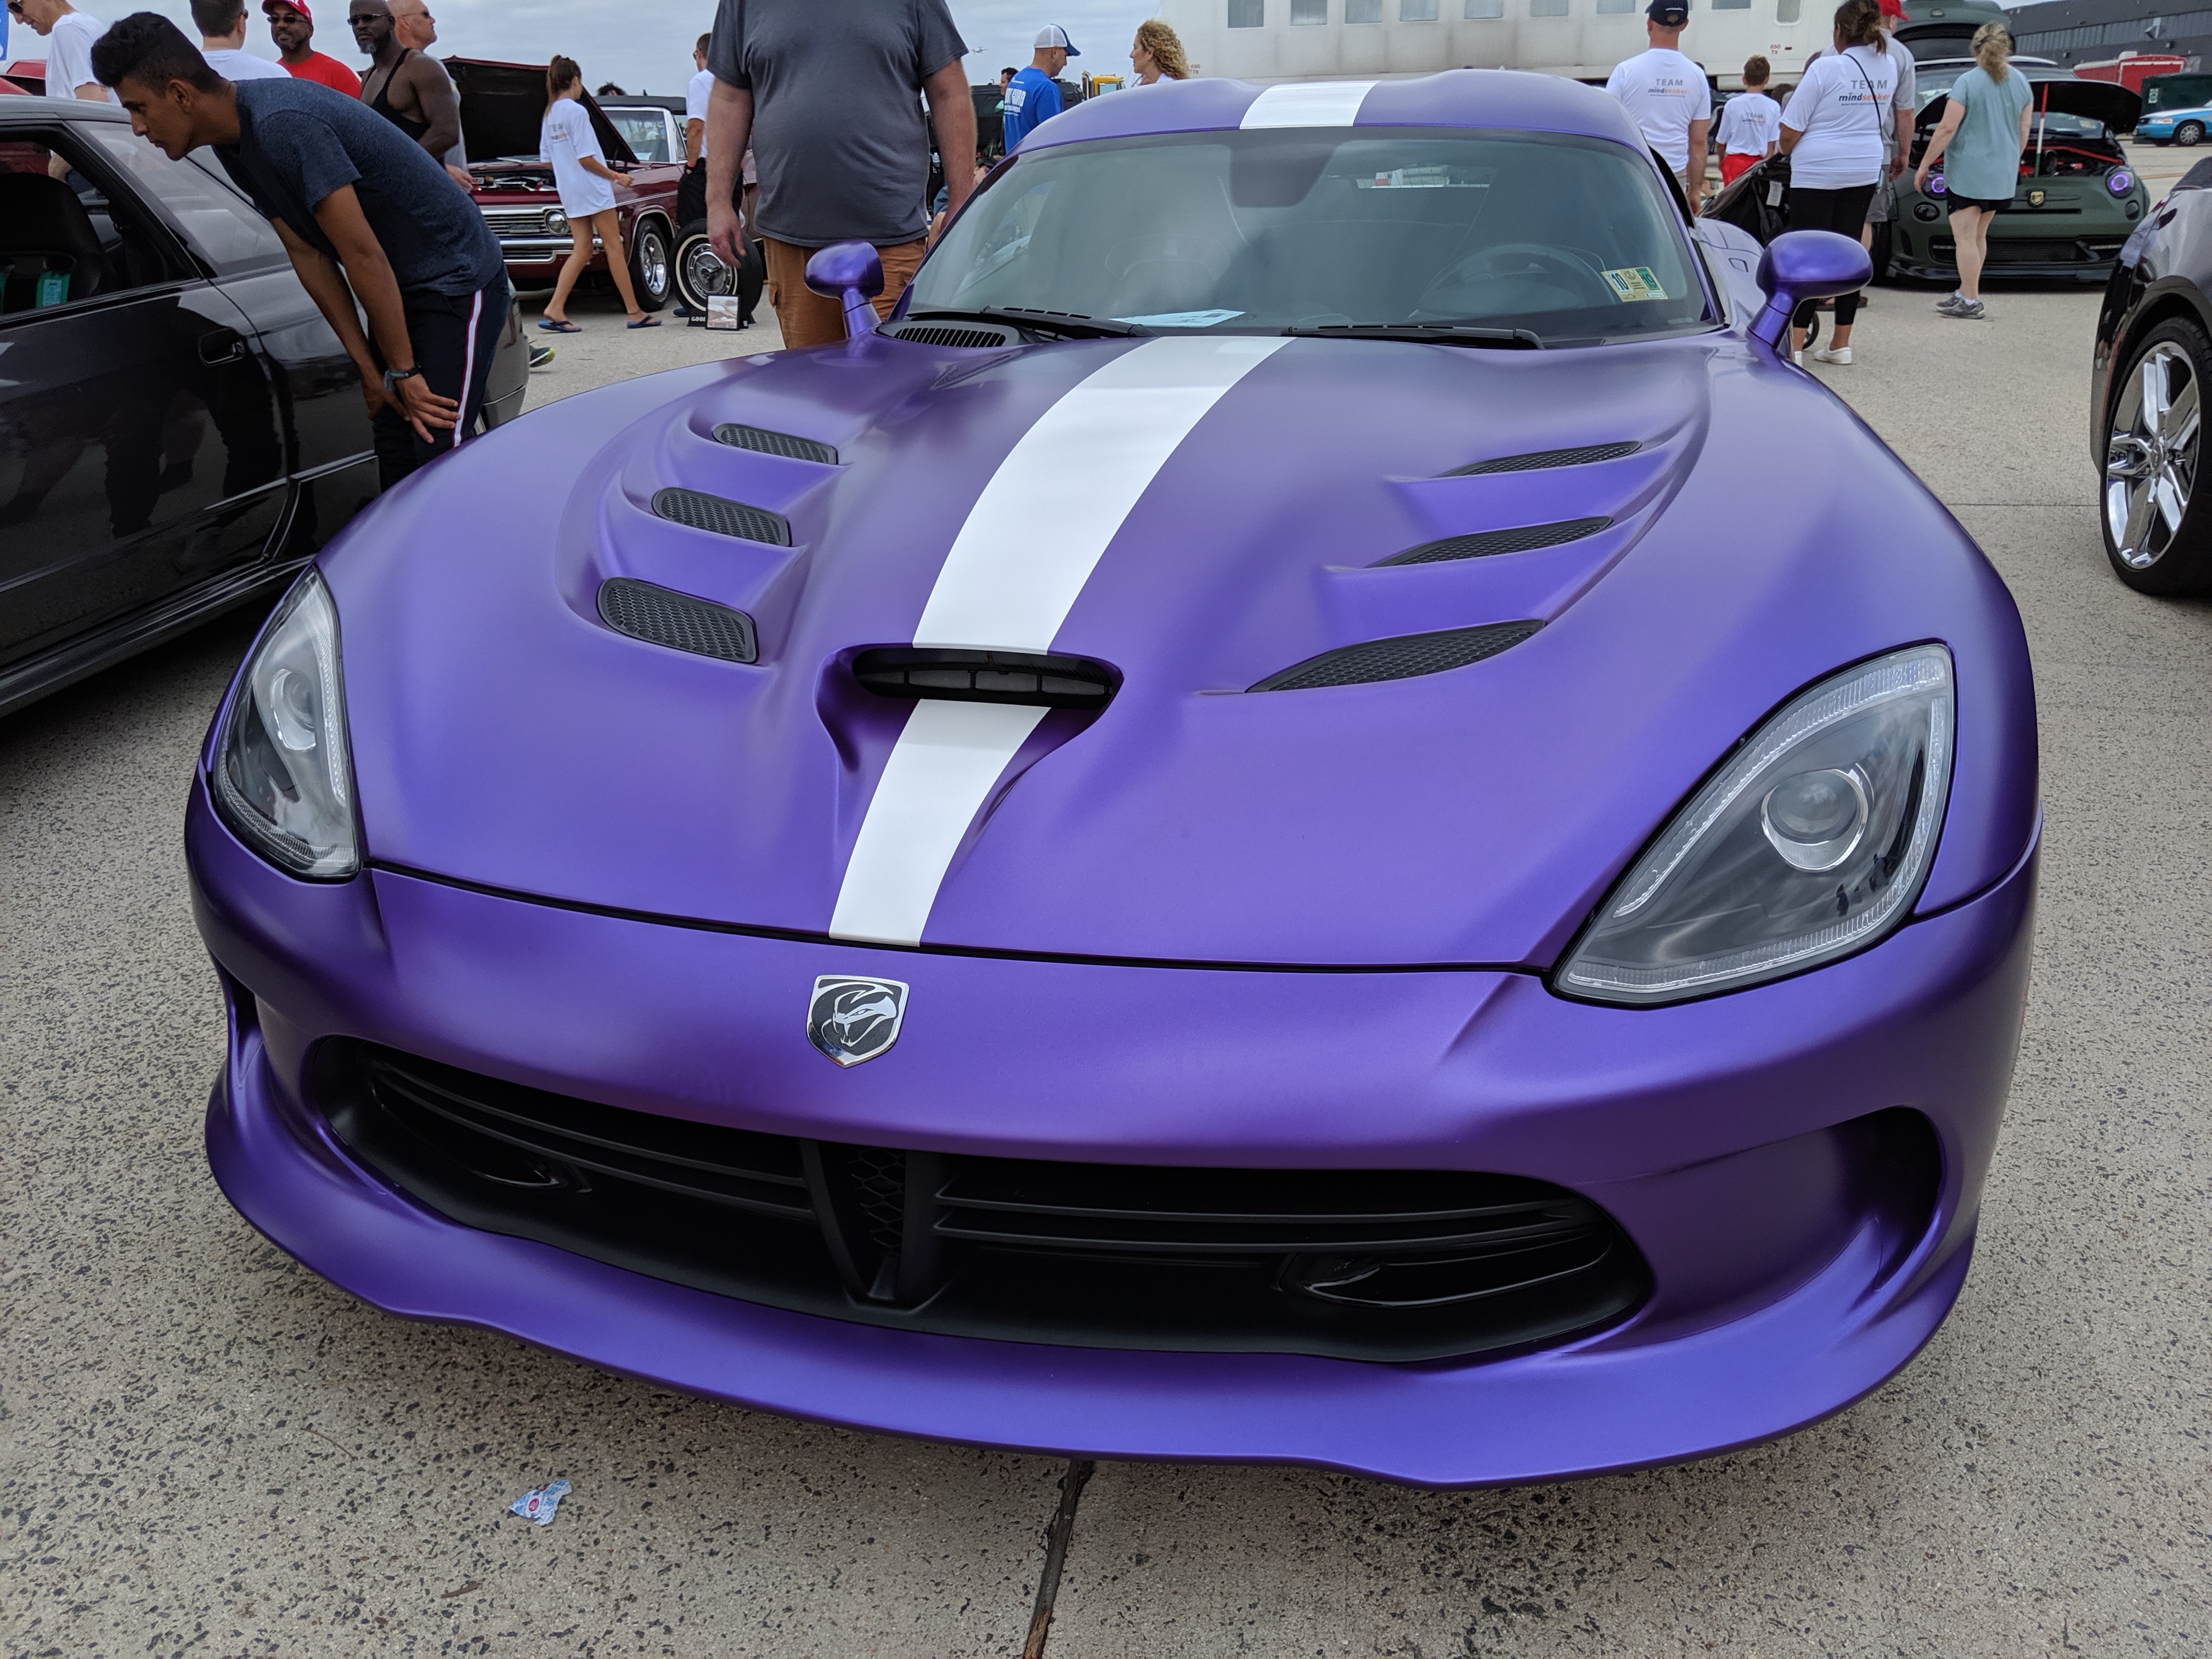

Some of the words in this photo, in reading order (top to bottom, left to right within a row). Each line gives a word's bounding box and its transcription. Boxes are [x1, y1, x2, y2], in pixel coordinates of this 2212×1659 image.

[1850, 80, 1888, 89] TEAM
[1611, 273, 1629, 291] 10
[1641, 273, 1658, 289] 19
